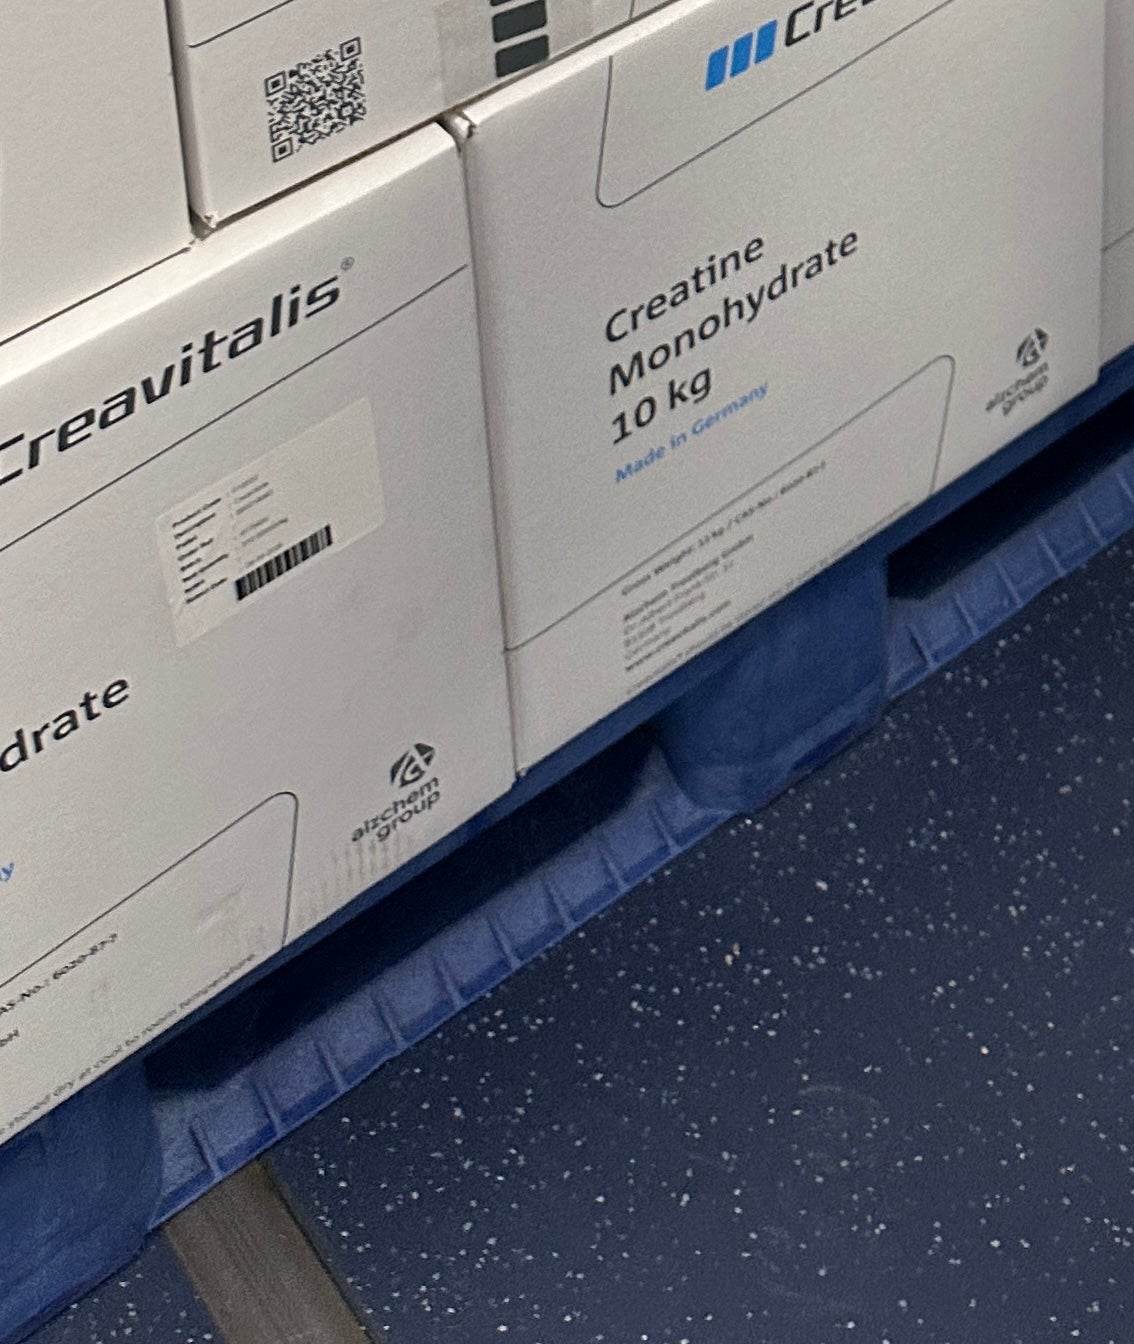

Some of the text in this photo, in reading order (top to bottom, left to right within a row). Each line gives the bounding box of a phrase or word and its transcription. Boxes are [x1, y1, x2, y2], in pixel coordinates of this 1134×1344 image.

[604, 236, 765, 343] Creatine
[608, 231, 859, 396] Monohydrate
[612, 367, 712, 446] 10 kg
[615, 383, 768, 483] Made in Germany
[351, 776, 440, 843] alzchem
[377, 791, 441, 843] group
